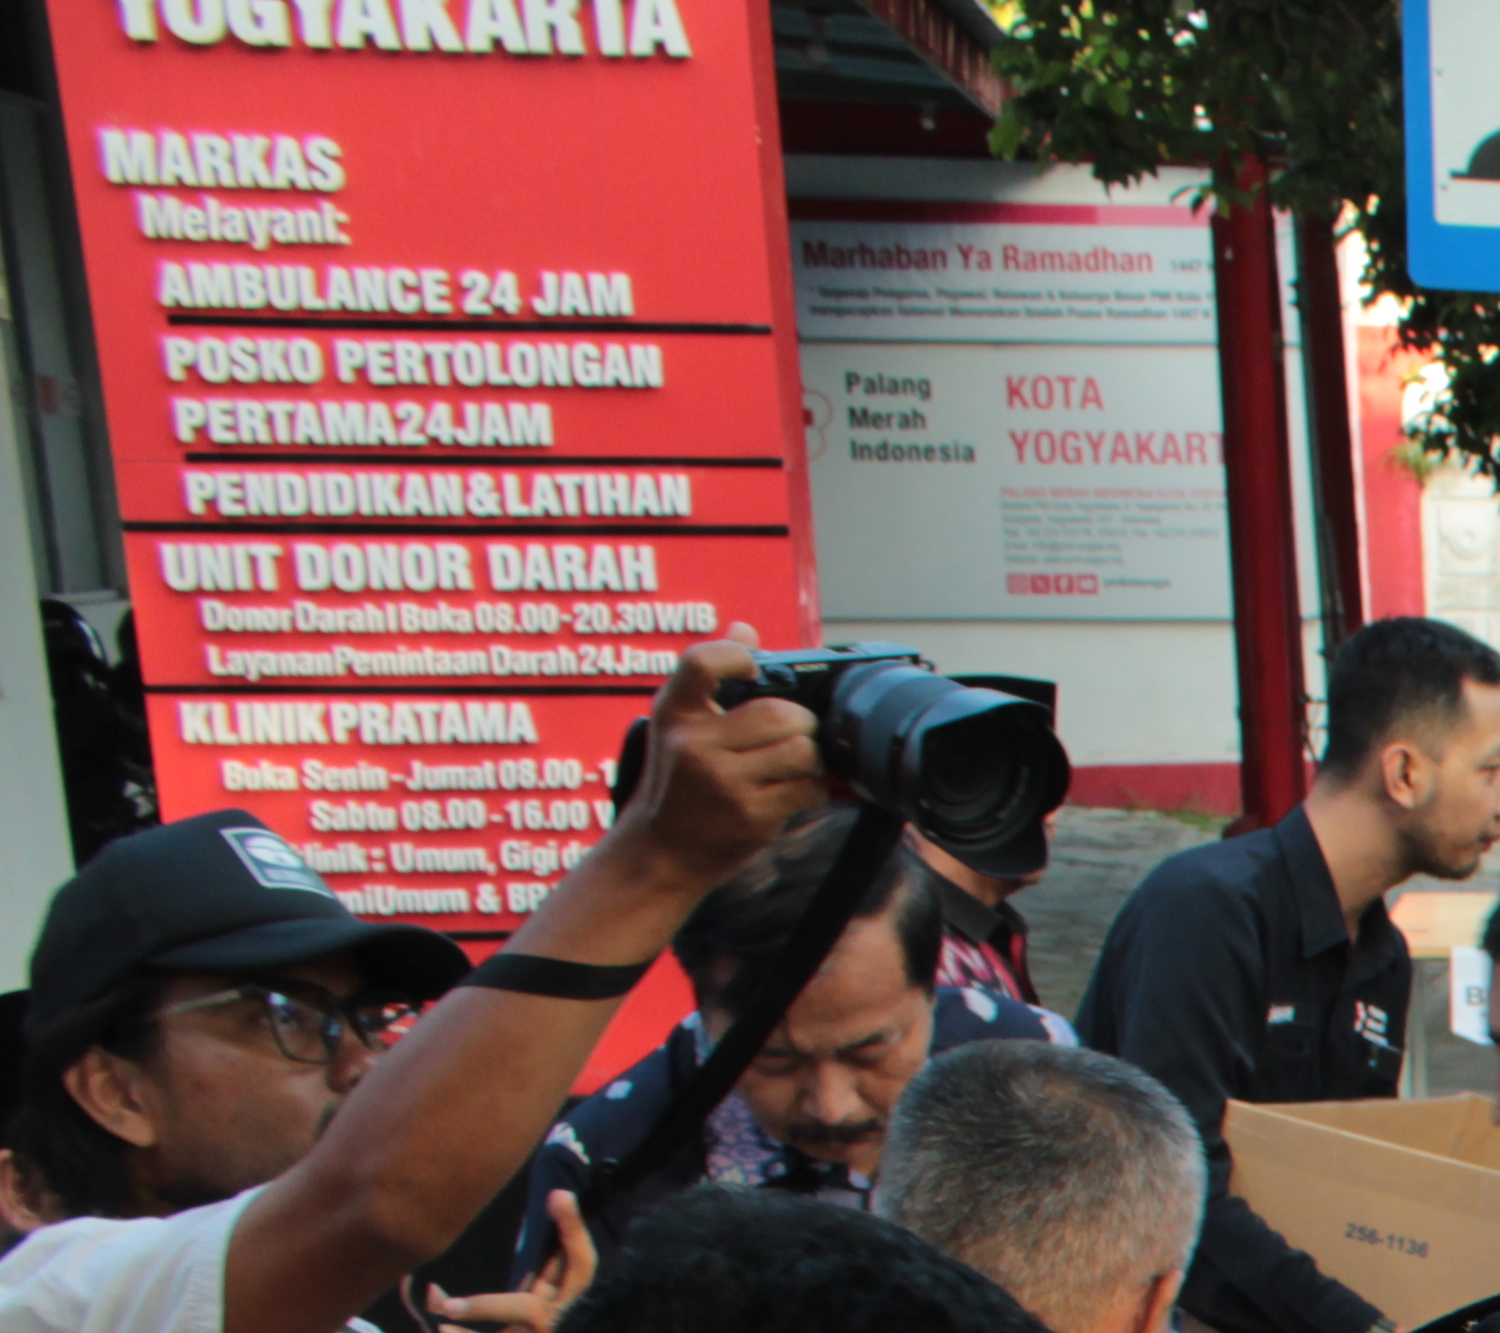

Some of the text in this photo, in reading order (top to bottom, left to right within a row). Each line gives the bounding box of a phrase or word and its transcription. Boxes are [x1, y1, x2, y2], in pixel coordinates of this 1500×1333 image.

[115, 0, 692, 58] YOGYAKARTA
[96, 124, 346, 193] MARKAS
[802, 241, 949, 271] Marhaban
[957, 243, 994, 272] Ya
[1001, 245, 1155, 274] Ramadhan
[157, 258, 635, 318] AMBULANCE 24 JAM
[159, 334, 664, 389] POSKO PERTOLONGAN
[844, 371, 932, 400] Palang
[1005, 376, 1105, 411] KOTA
[847, 406, 926, 430] Merah
[849, 438, 976, 464] Indonesia
[1008, 430, 1225, 466] YOGYAKART
[158, 540, 659, 594] UNIT DONOR DARAH
[400, 600, 474, 634] Buka
[474, 601, 560, 634] 08.00
[571, 601, 656, 634] 20.30
[178, 700, 540, 745] KLINIK PRATAMA
[220, 758, 299, 792] Buka
[301, 758, 390, 793] Senin
[500, 758, 584, 792] 08.00
[308, 798, 398, 832] Sabtu
[402, 798, 487, 832] 08.00
[505, 799, 591, 832] 16.00
[298, 841, 369, 874] linik
[388, 842, 497, 875] Umum,
[500, 839, 560, 876] Gigi
[475, 884, 502, 914] &
[1342, 1220, 1431, 1260] 256-1136
